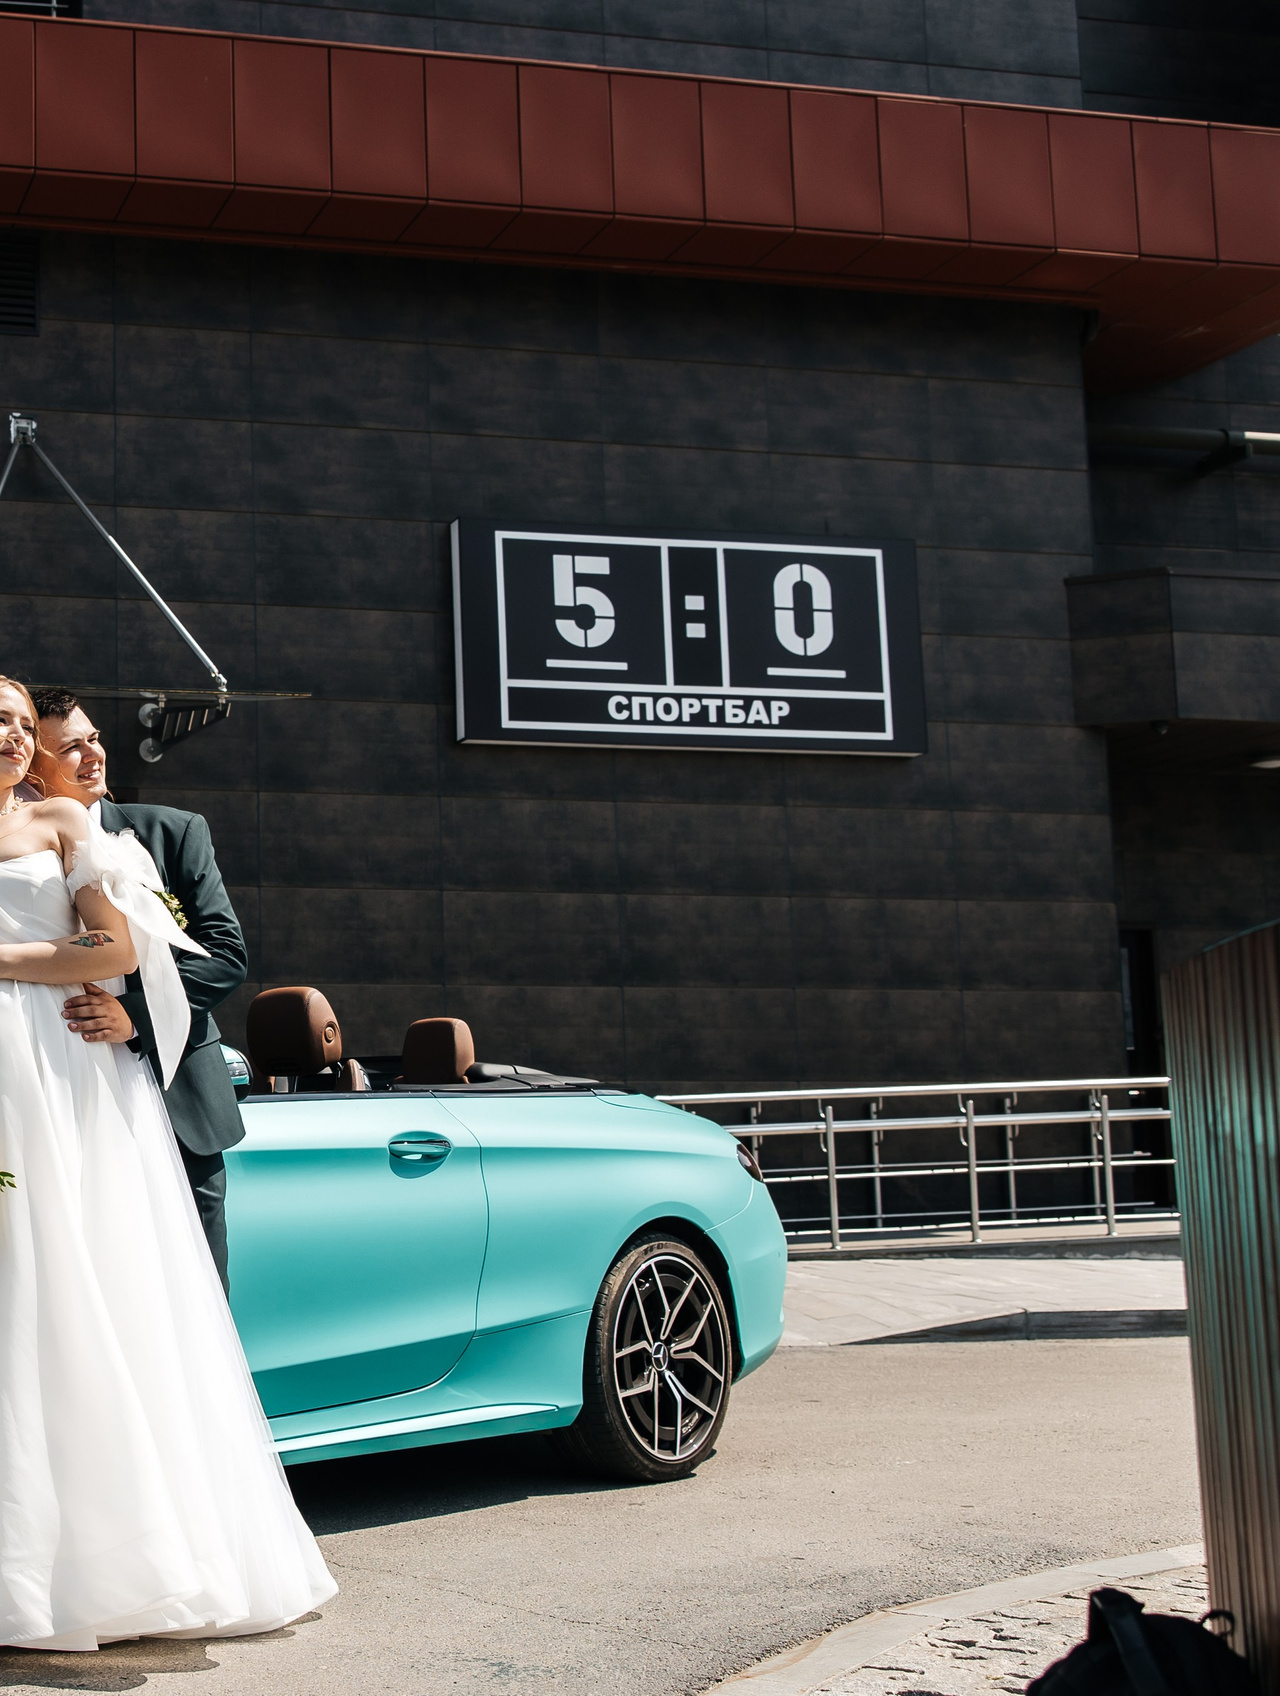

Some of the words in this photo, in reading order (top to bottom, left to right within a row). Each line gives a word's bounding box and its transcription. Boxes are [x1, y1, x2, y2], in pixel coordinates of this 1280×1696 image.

[552, 554, 616, 648] 5
[773, 562, 835, 657] 0
[606, 695, 791, 725] СПОРТБАР
